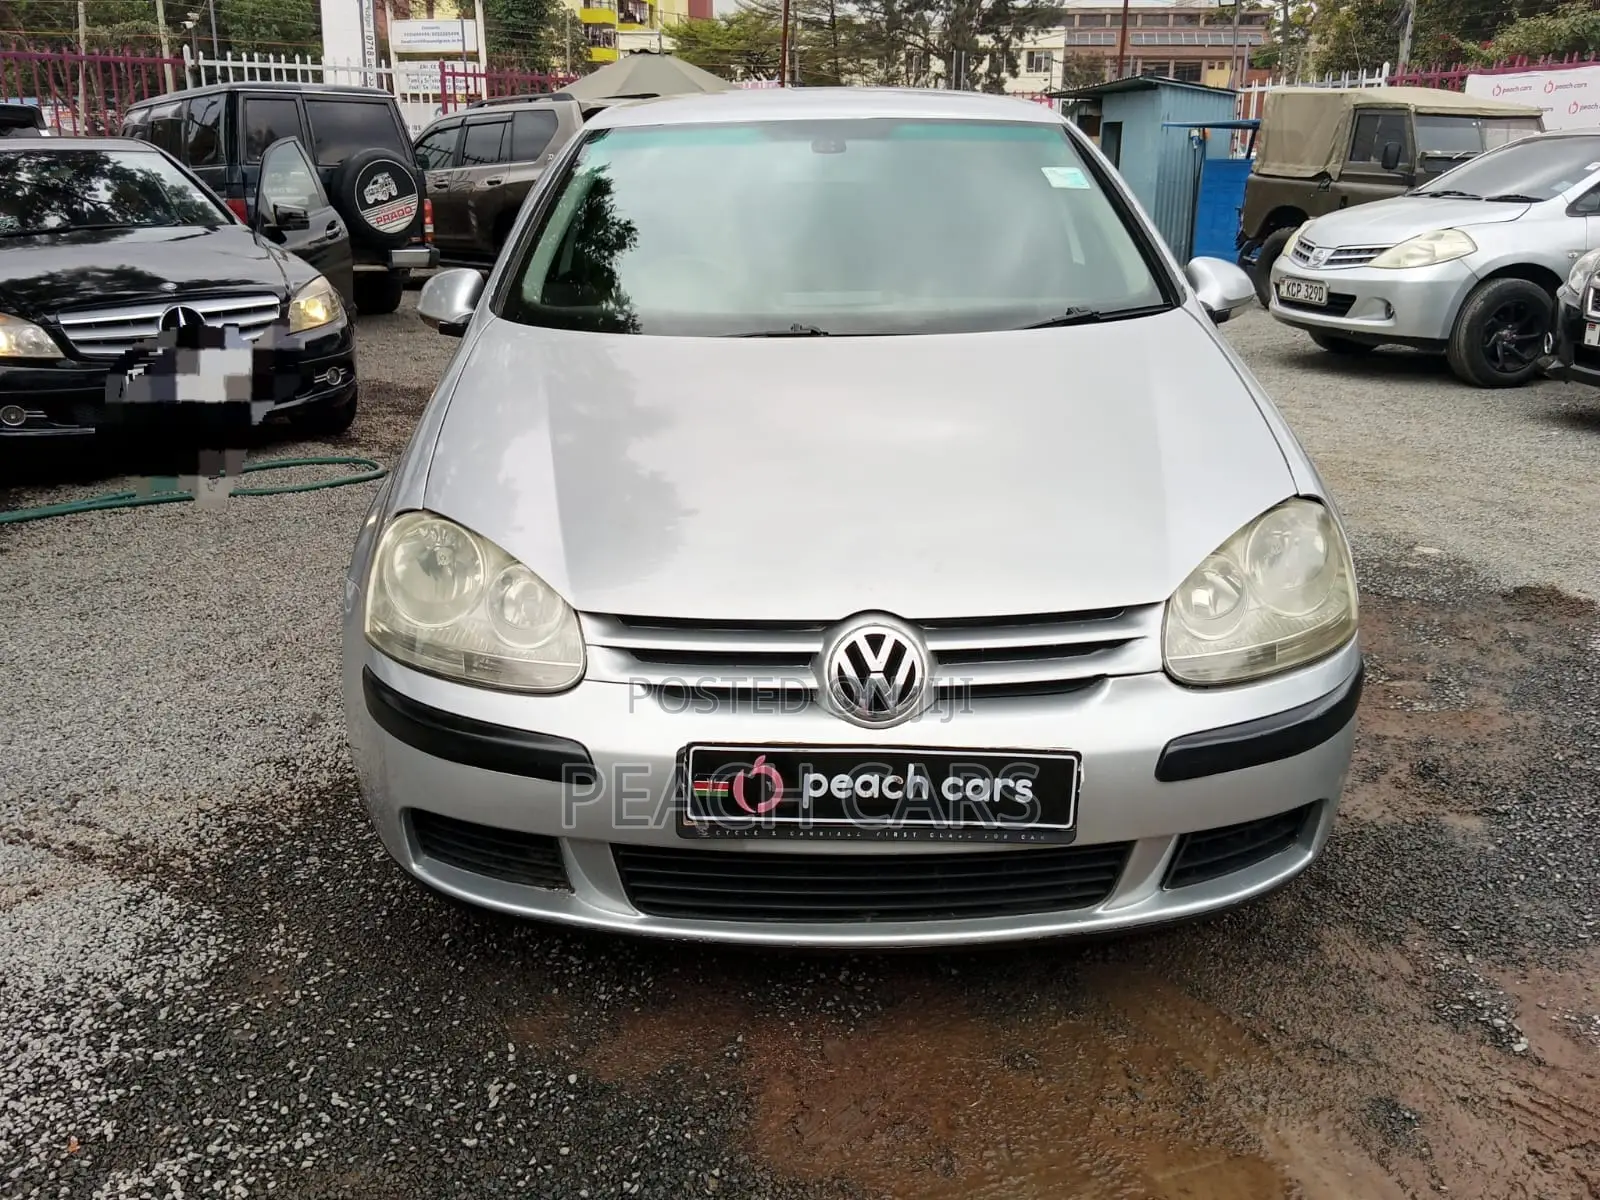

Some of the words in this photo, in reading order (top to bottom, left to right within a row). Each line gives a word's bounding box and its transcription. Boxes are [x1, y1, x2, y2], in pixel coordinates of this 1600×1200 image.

[376, 206, 412, 225] PRADO
[1286, 282, 1302, 298] KCP
[1304, 284, 1324, 302] 329D
[802, 763, 929, 809] peach
[941, 776, 1034, 804] cars
[876, 830, 917, 838] FIRST
